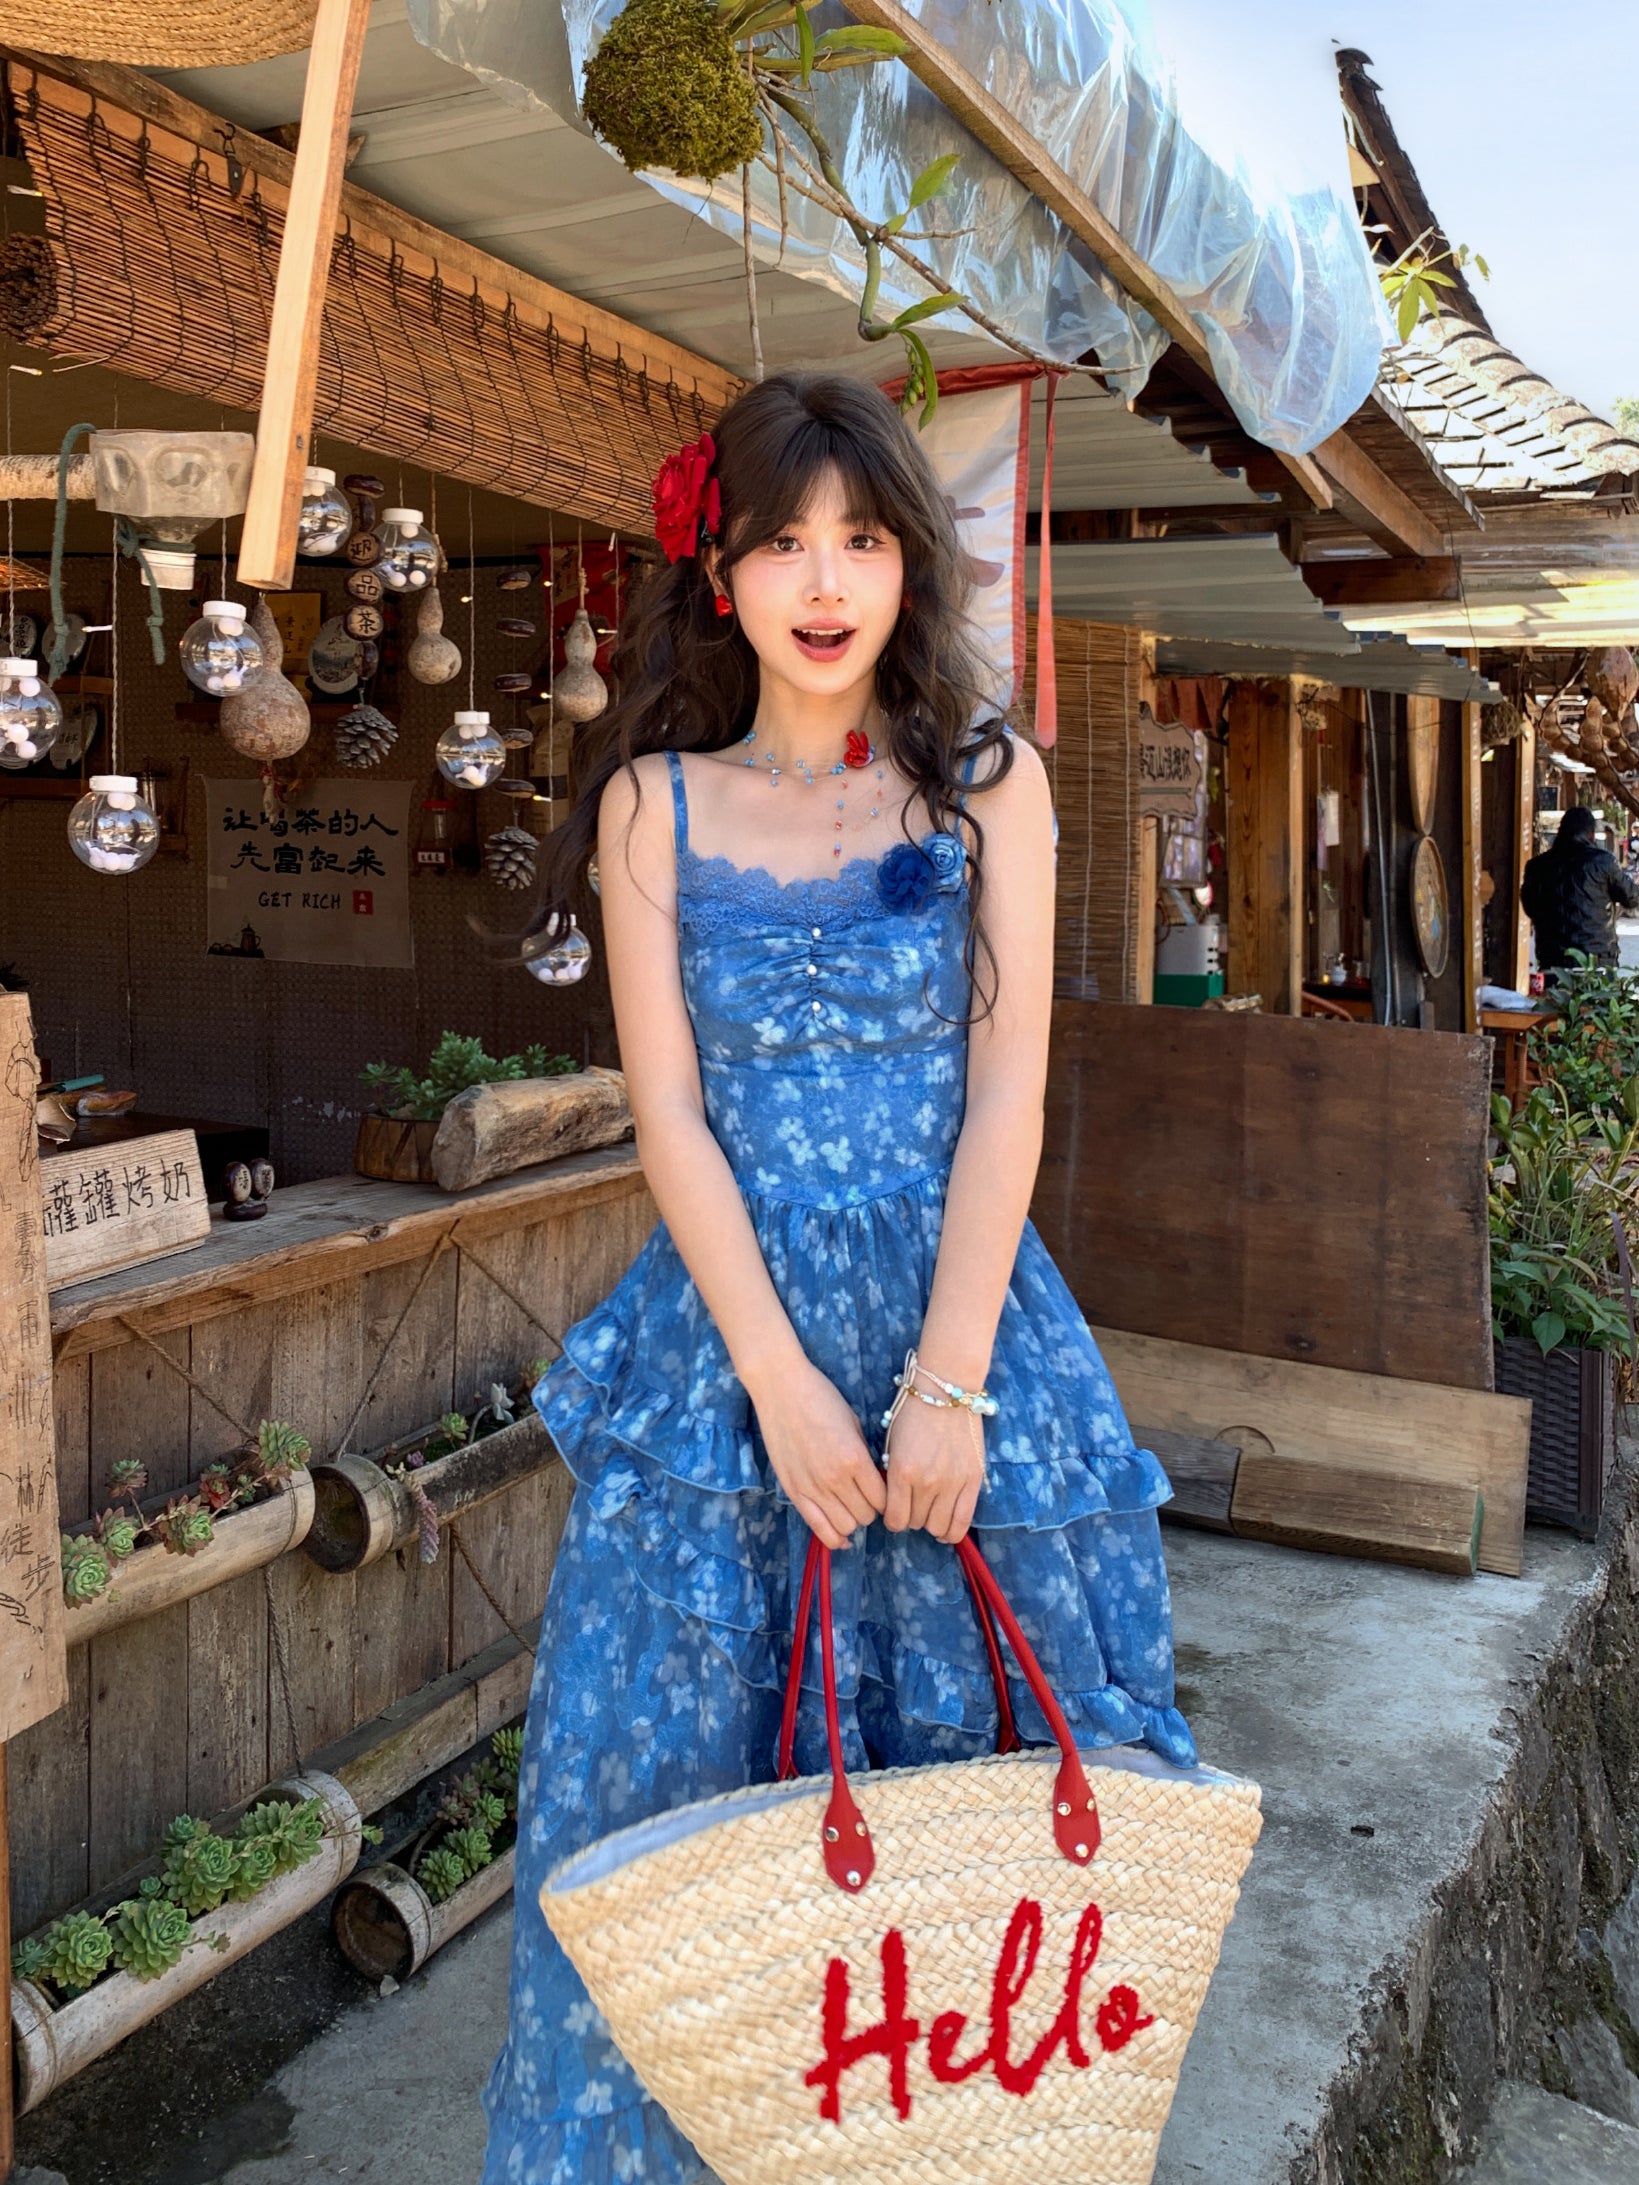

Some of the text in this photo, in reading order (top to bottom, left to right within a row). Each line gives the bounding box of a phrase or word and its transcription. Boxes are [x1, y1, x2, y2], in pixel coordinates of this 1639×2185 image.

[230, 841, 386, 877] 先富起来
[258, 891, 292, 908] GET
[302, 892, 341, 910] RICH
[805, 1896, 1154, 2126] Hello
